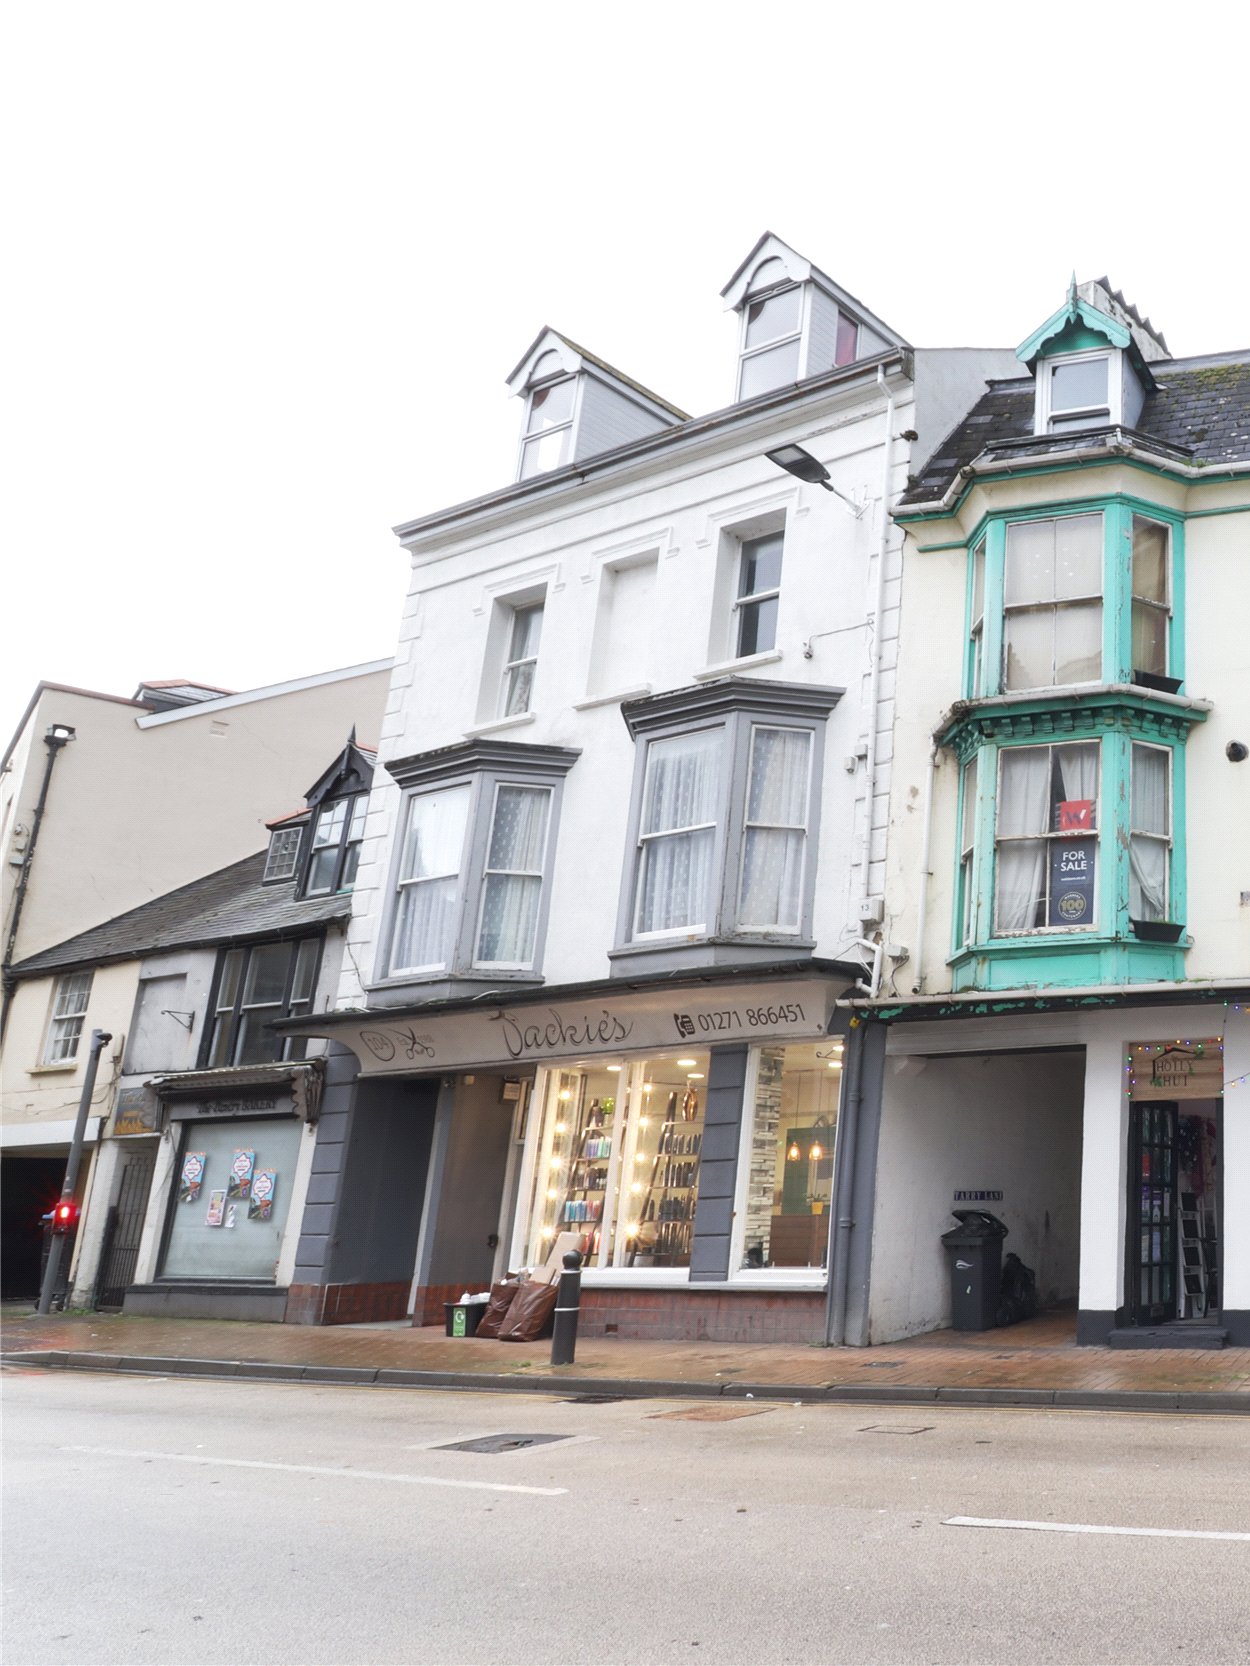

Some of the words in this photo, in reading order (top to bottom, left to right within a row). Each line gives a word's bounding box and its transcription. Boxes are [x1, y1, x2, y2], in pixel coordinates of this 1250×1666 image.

[1062, 850, 1085, 861] FOR
[1060, 860, 1087, 871] SALE
[1061, 900, 1084, 911] 100
[697, 1010, 742, 1032] 01271
[746, 1003, 806, 1027] 866451
[489, 1008, 634, 1058] Jackie's
[1156, 1060, 1194, 1073] HOLLY
[1163, 1075, 1188, 1088] HUT
